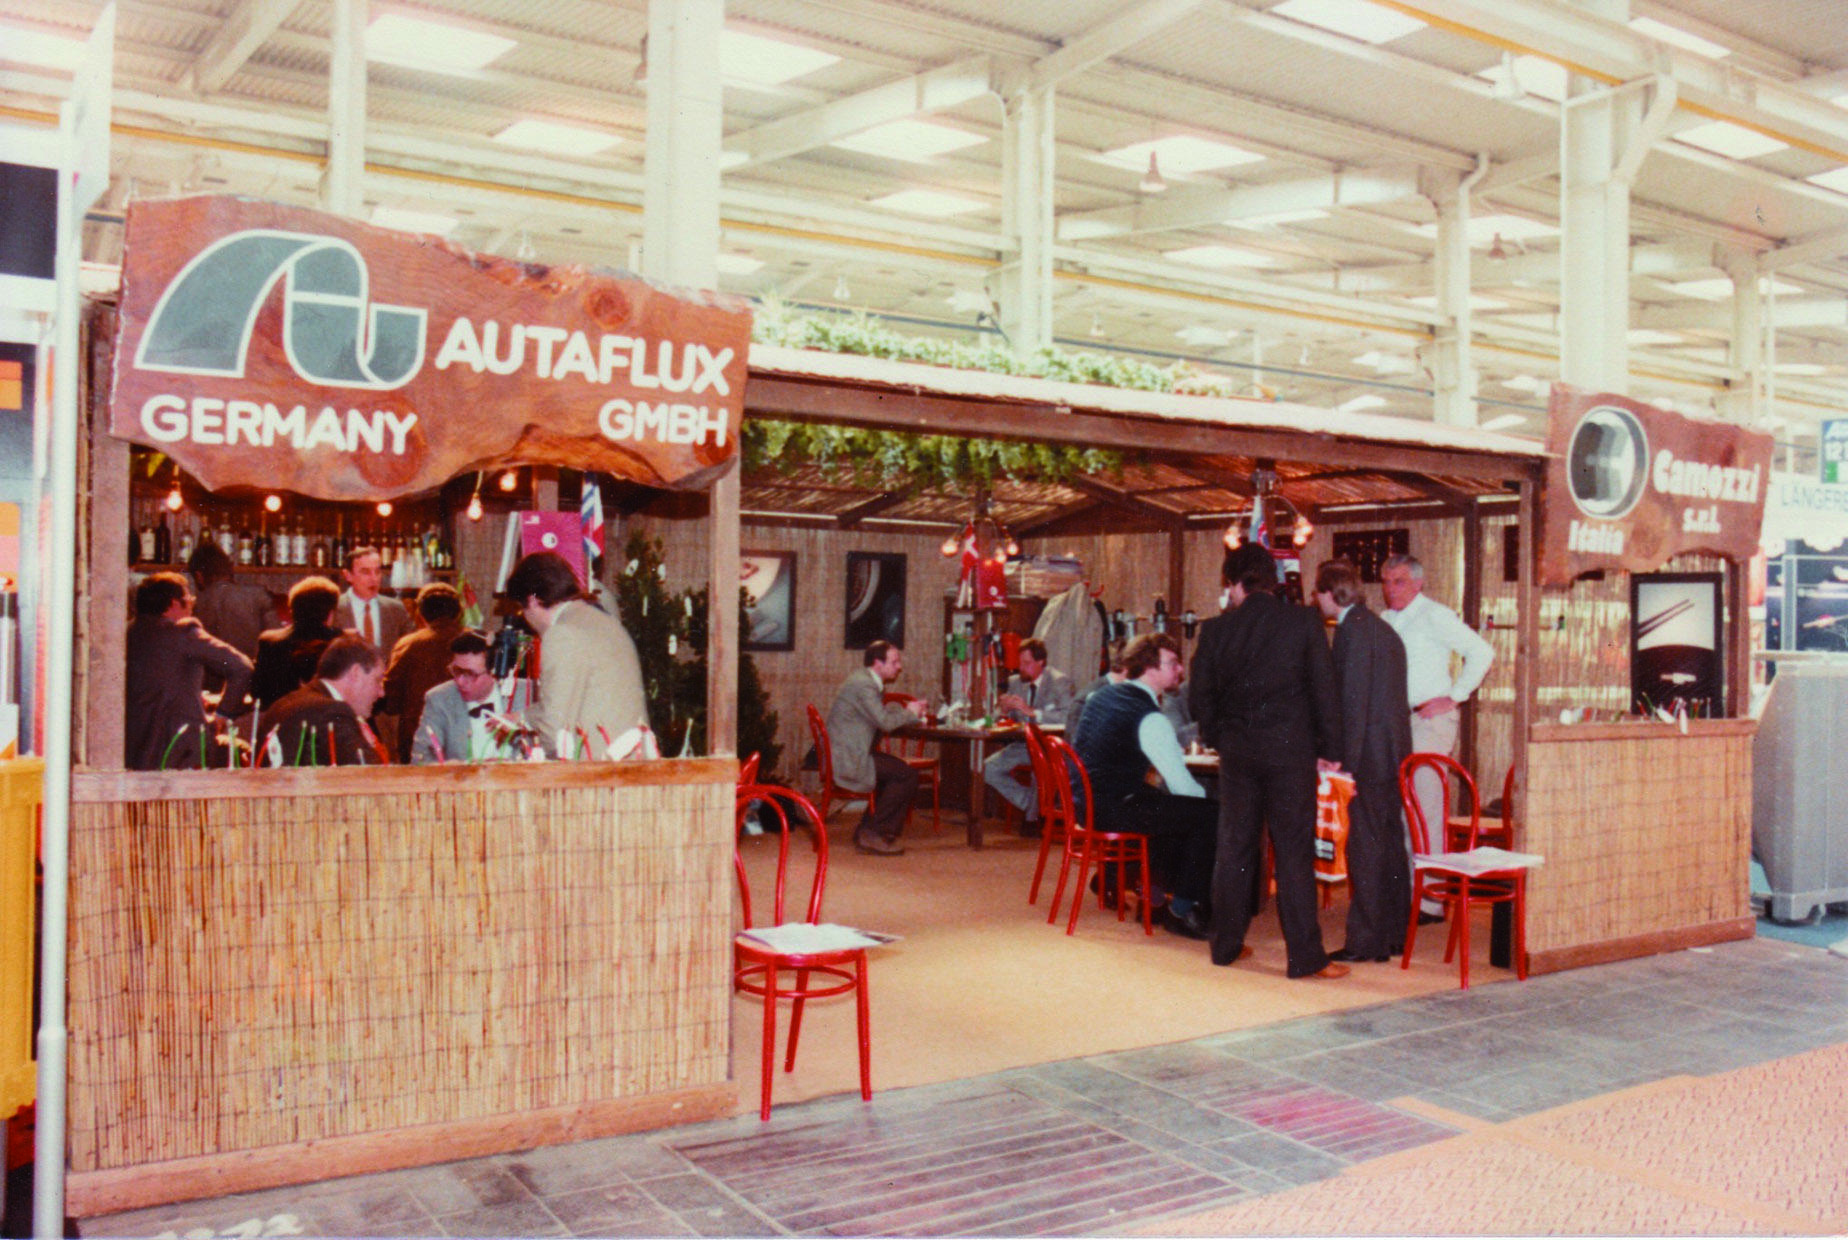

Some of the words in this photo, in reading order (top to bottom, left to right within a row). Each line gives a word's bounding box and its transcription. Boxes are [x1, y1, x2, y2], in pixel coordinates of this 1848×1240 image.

[435, 317, 734, 396] AUTAFLUX
[140, 394, 418, 455] GERMANY
[599, 399, 728, 447] GMBH
[1653, 449, 1761, 504] Camozzi
[1567, 519, 1624, 556] Italia
